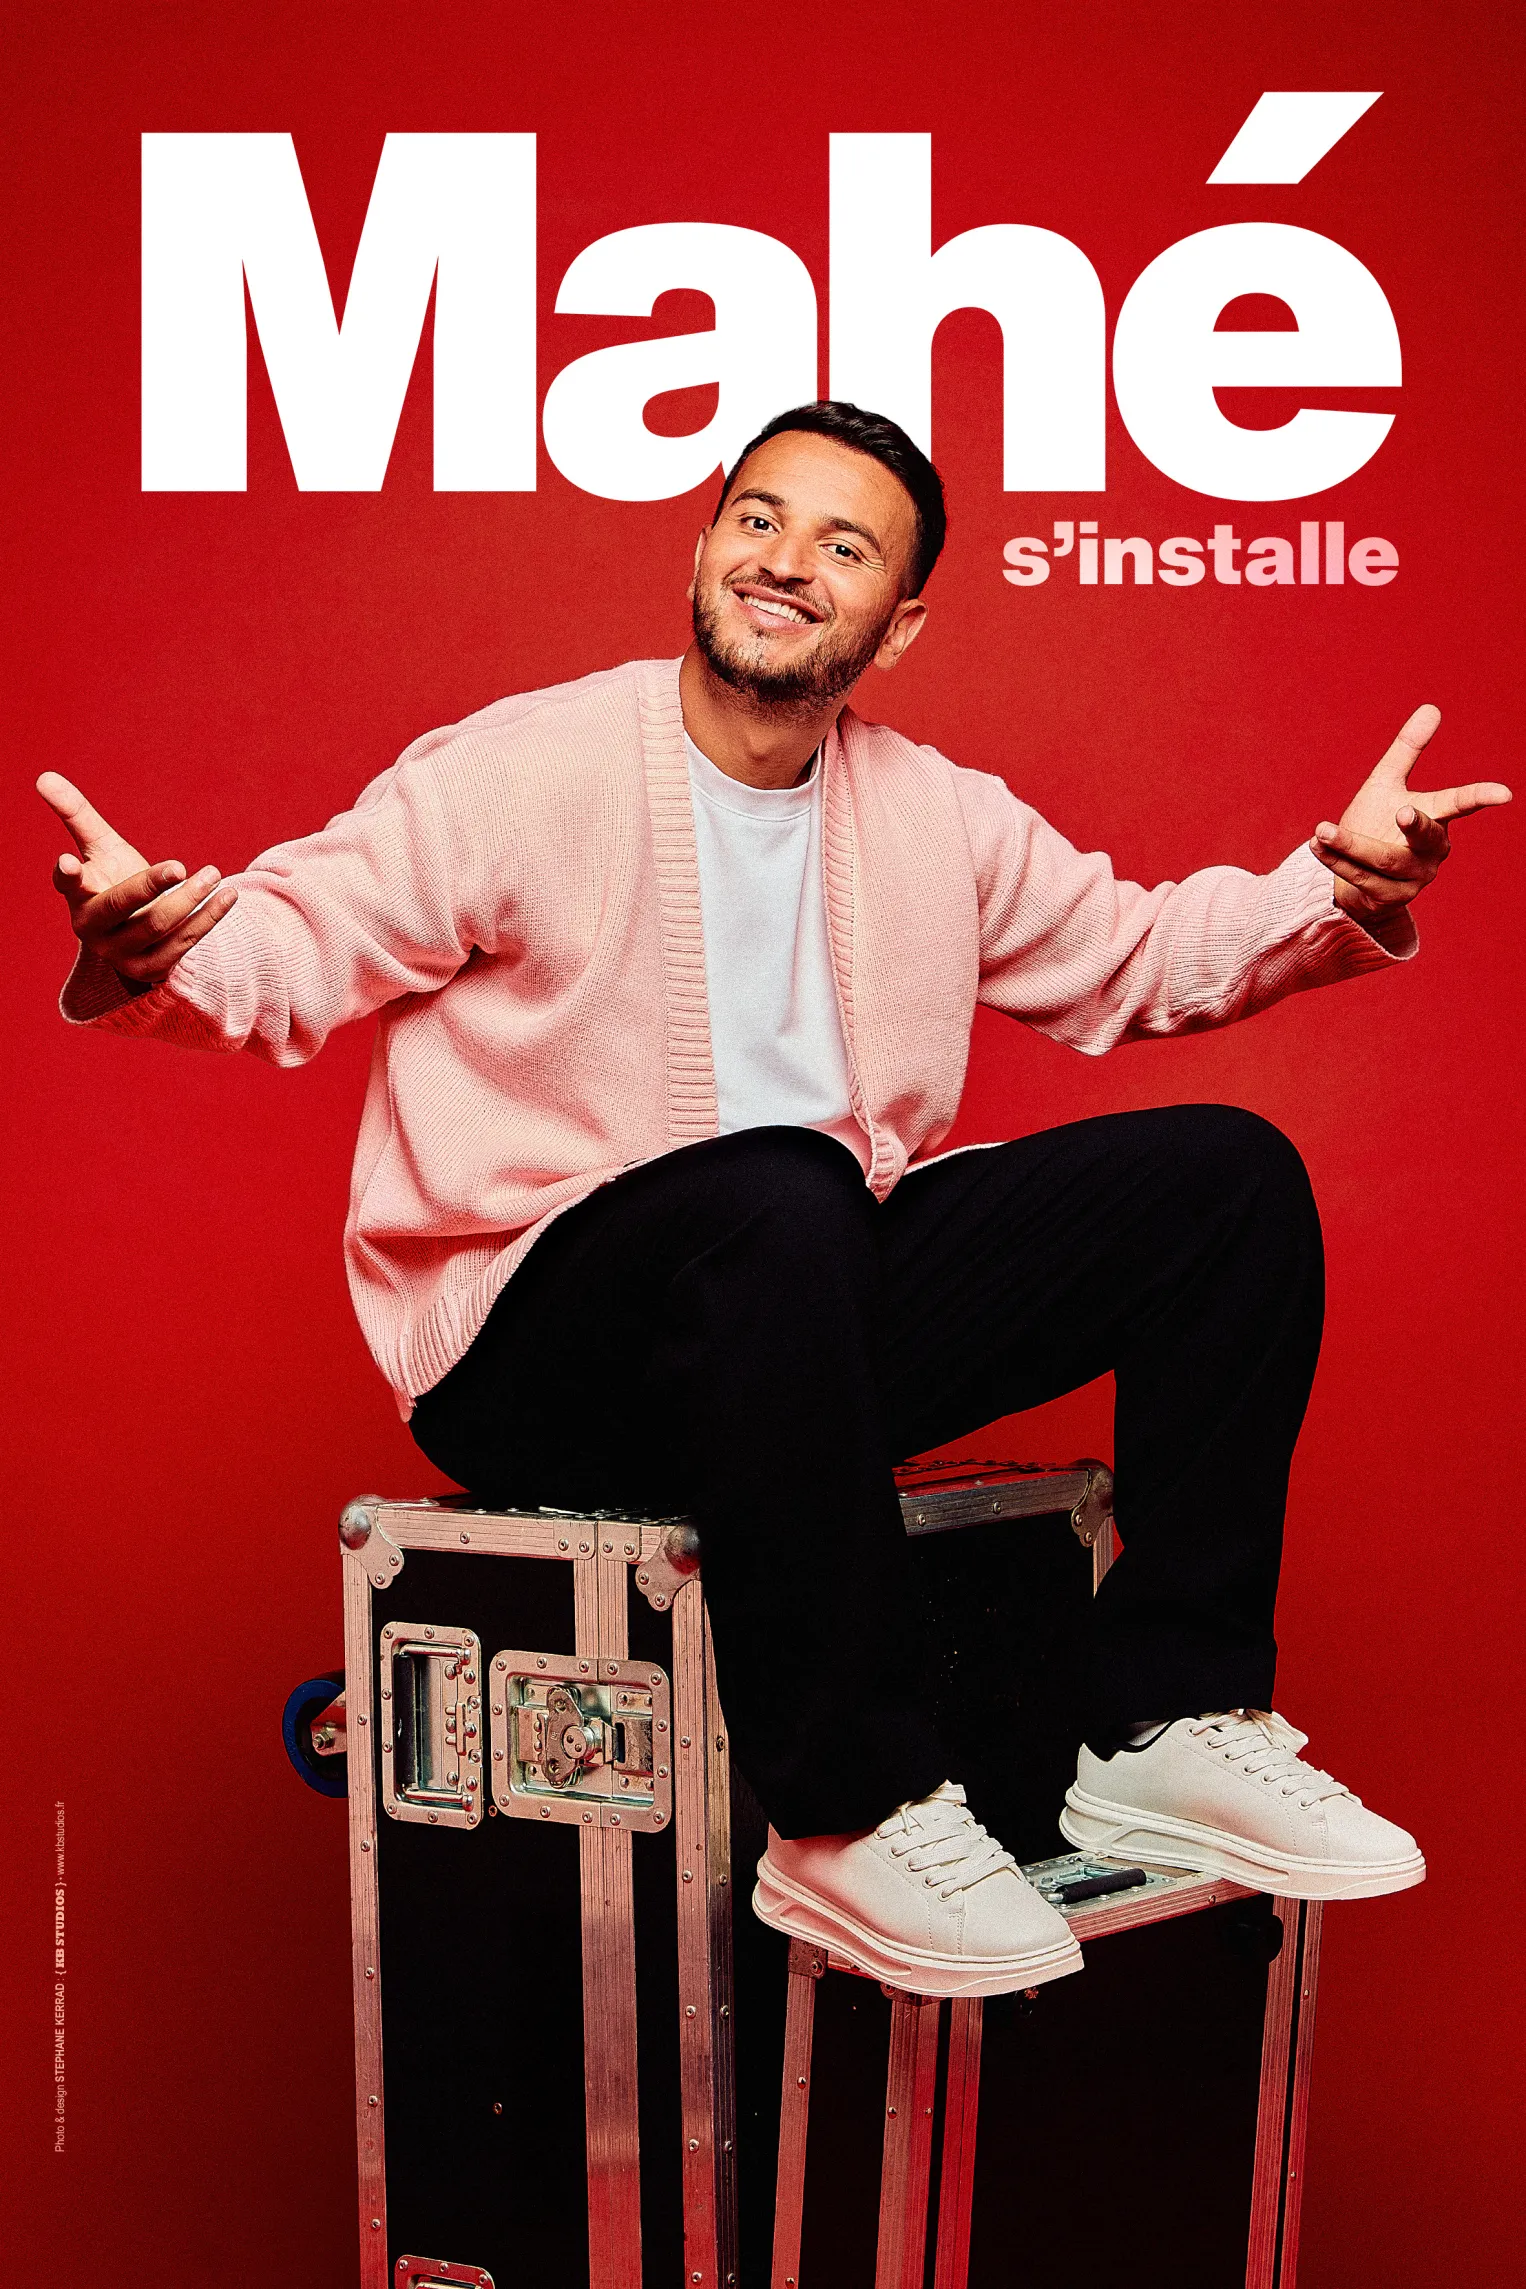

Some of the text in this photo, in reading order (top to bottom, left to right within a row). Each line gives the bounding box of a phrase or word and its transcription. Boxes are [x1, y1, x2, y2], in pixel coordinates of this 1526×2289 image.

[141, 92, 1402, 502] Mahé
[1002, 521, 1399, 586] s’installe
[55, 1801, 64, 1876] www.kbstudios.fr
[55, 1889, 64, 1946] STUDIOS
[55, 1949, 64, 1969] KB
[55, 1984, 64, 2026] KERRAD
[55, 2028, 64, 2082] STEPHANE
[55, 2085, 67, 2115] design
[55, 2116, 64, 2124] &
[55, 2126, 64, 2152] Photo
